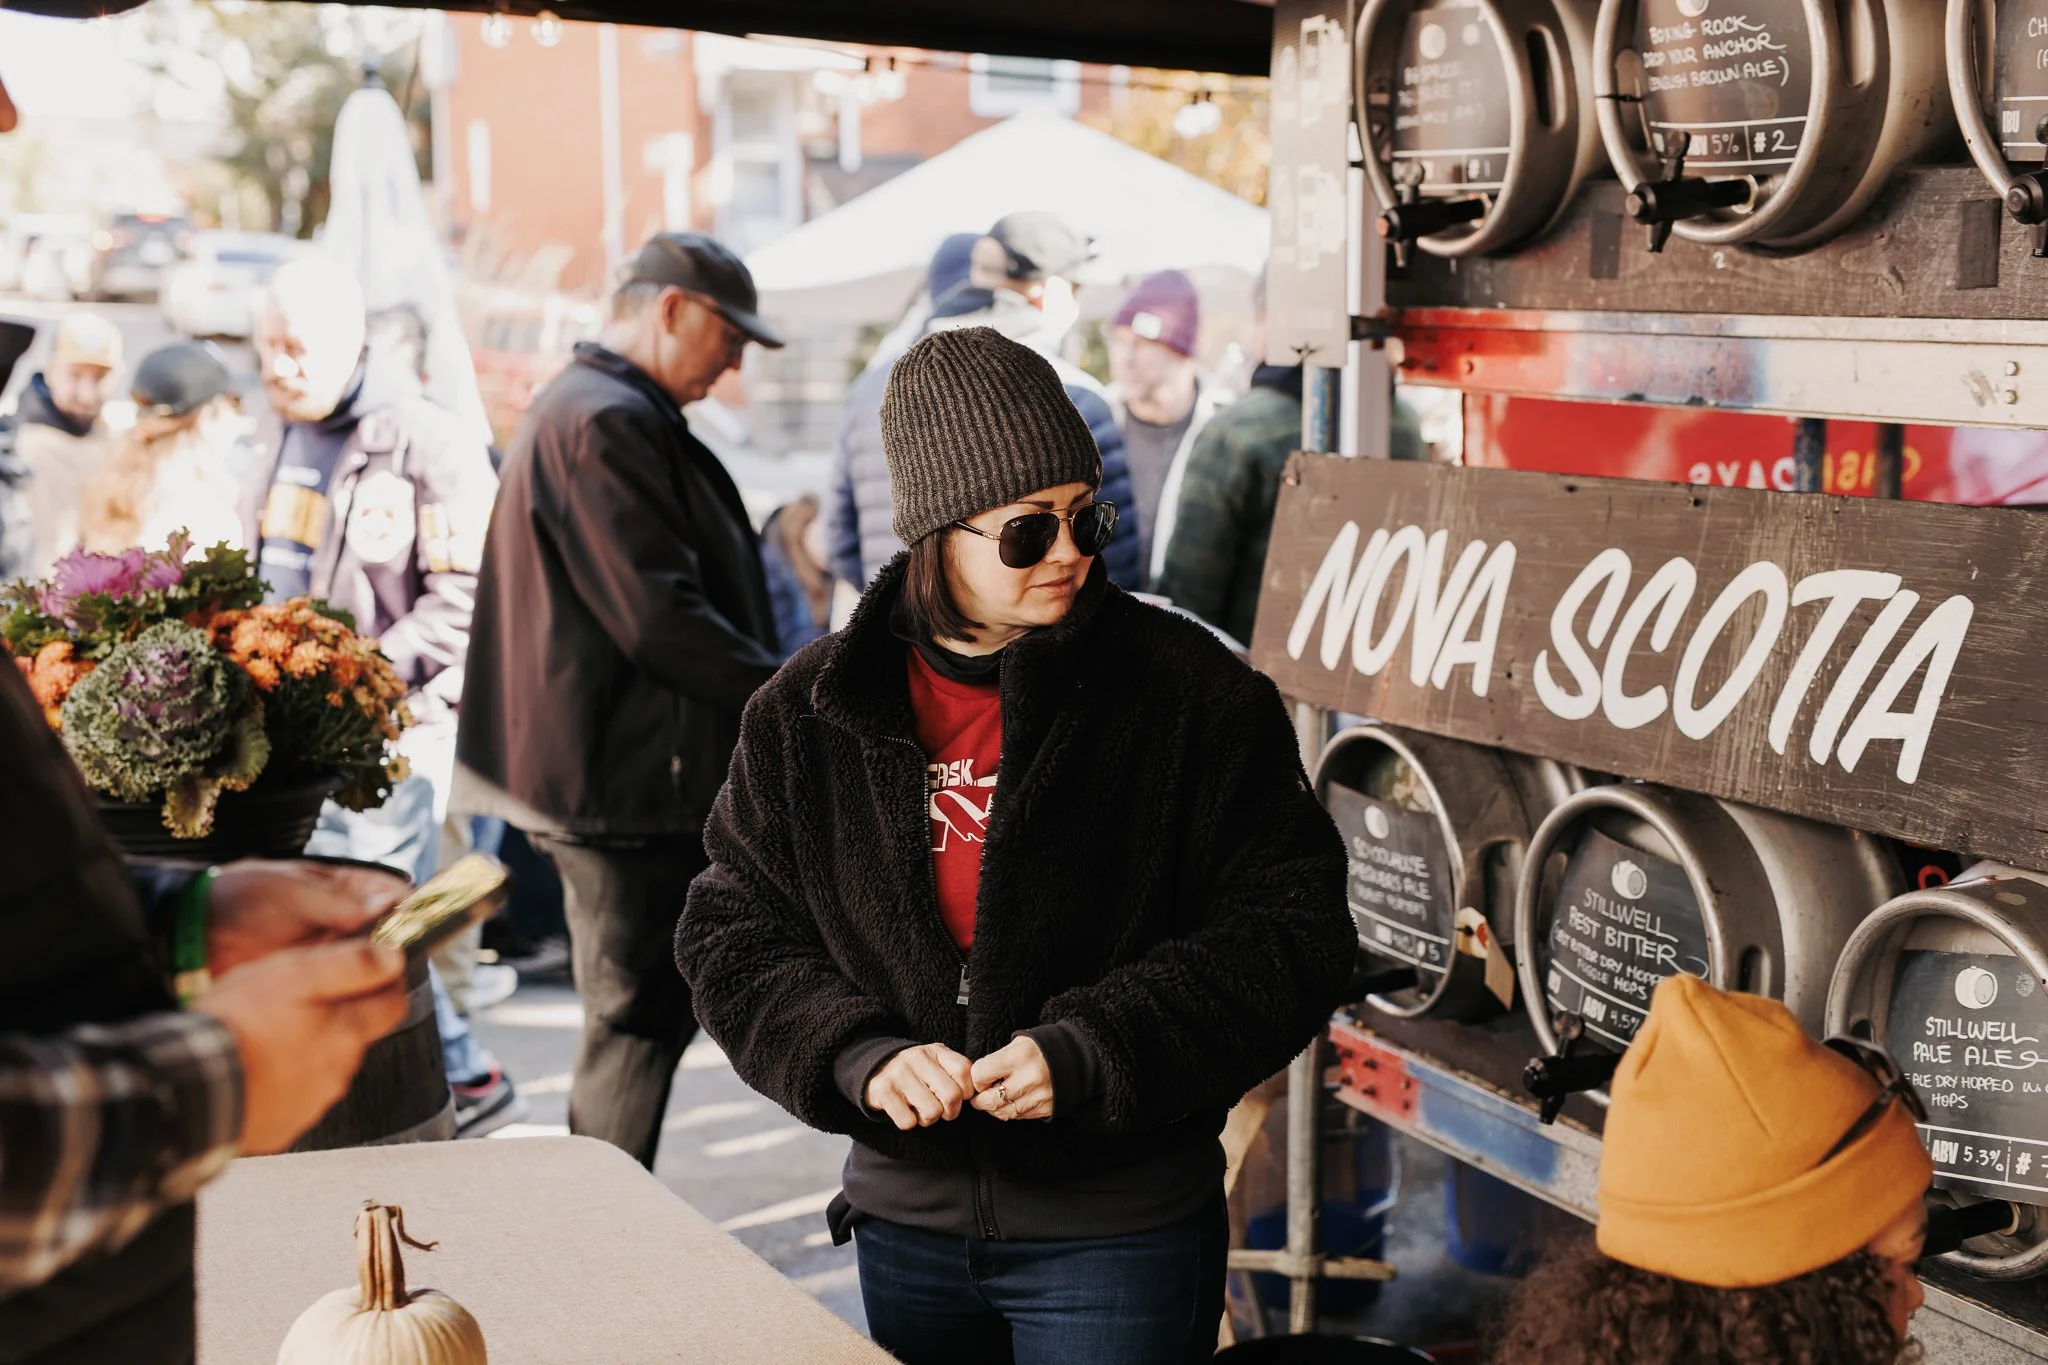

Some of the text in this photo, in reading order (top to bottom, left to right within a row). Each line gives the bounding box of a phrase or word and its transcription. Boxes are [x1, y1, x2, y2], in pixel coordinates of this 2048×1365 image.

[1701, 15, 1766, 36] ROCK
[1702, 32, 1787, 61] ANCHOR
[1691, 64, 1739, 88] BROWN
[1743, 56, 1790, 88] ALE)
[2002, 110, 2020, 134] IBU
[1287, 519, 1975, 786] NOVA SCOTIA
[1584, 888, 1680, 943] STILLWELL
[1569, 905, 1692, 974] BEST BITTER
[1600, 956, 1624, 974] DRY
[1614, 975, 1649, 1001] HOPS
[1583, 996, 1607, 1024] ABV
[1925, 1016, 2039, 1044] STILLWELL
[1913, 1041, 2031, 1070] PALE ALE
[1912, 1073, 1932, 1088] ALE
[1935, 1075, 1958, 1088] DRY
[1961, 1076, 2014, 1093] HOPPED
[1931, 1093, 1969, 1110] HOPS
[1931, 1139, 1959, 1164] ABV
[1963, 1146, 2005, 1172] 5.3%
